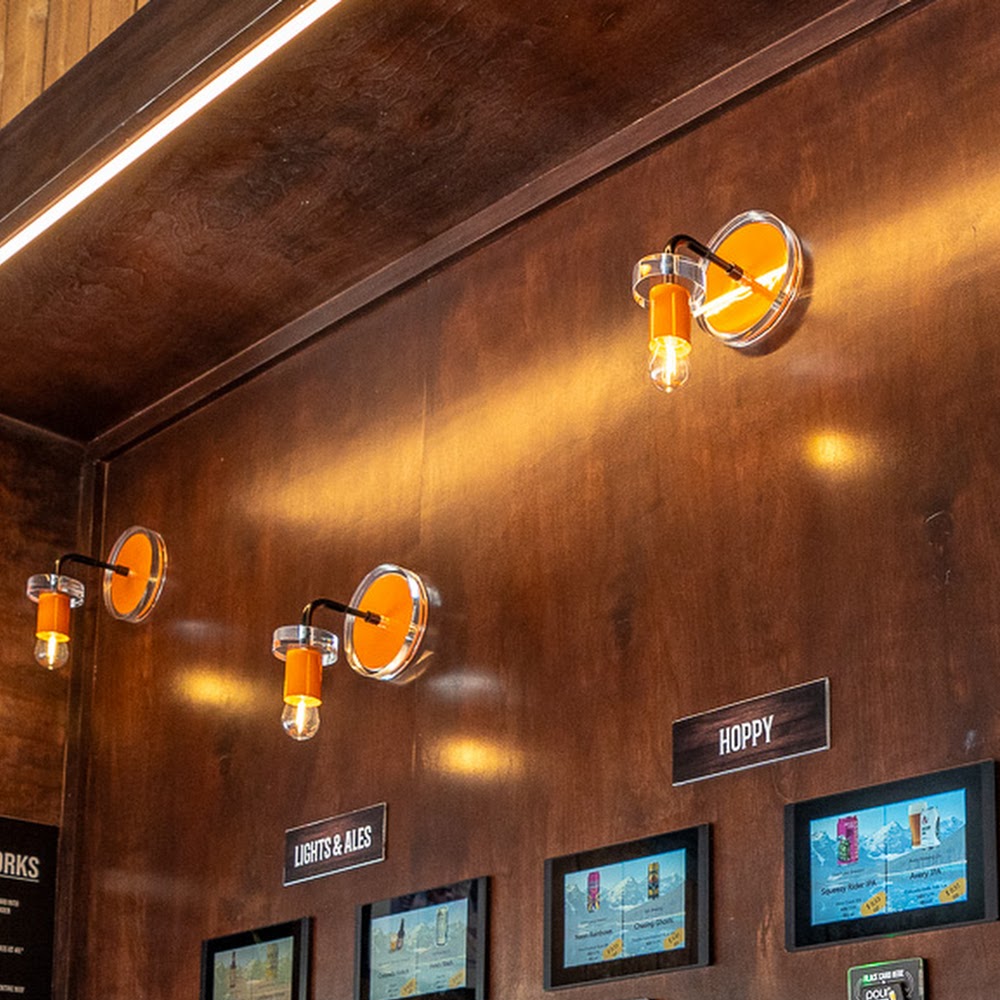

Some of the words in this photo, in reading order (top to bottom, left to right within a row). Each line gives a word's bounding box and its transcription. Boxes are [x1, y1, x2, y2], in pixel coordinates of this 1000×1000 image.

[719, 714, 774, 756] HOPPY
[294, 836, 332, 868] LIGHTS
[332, 833, 343, 857] &
[344, 825, 372, 854] ALES
